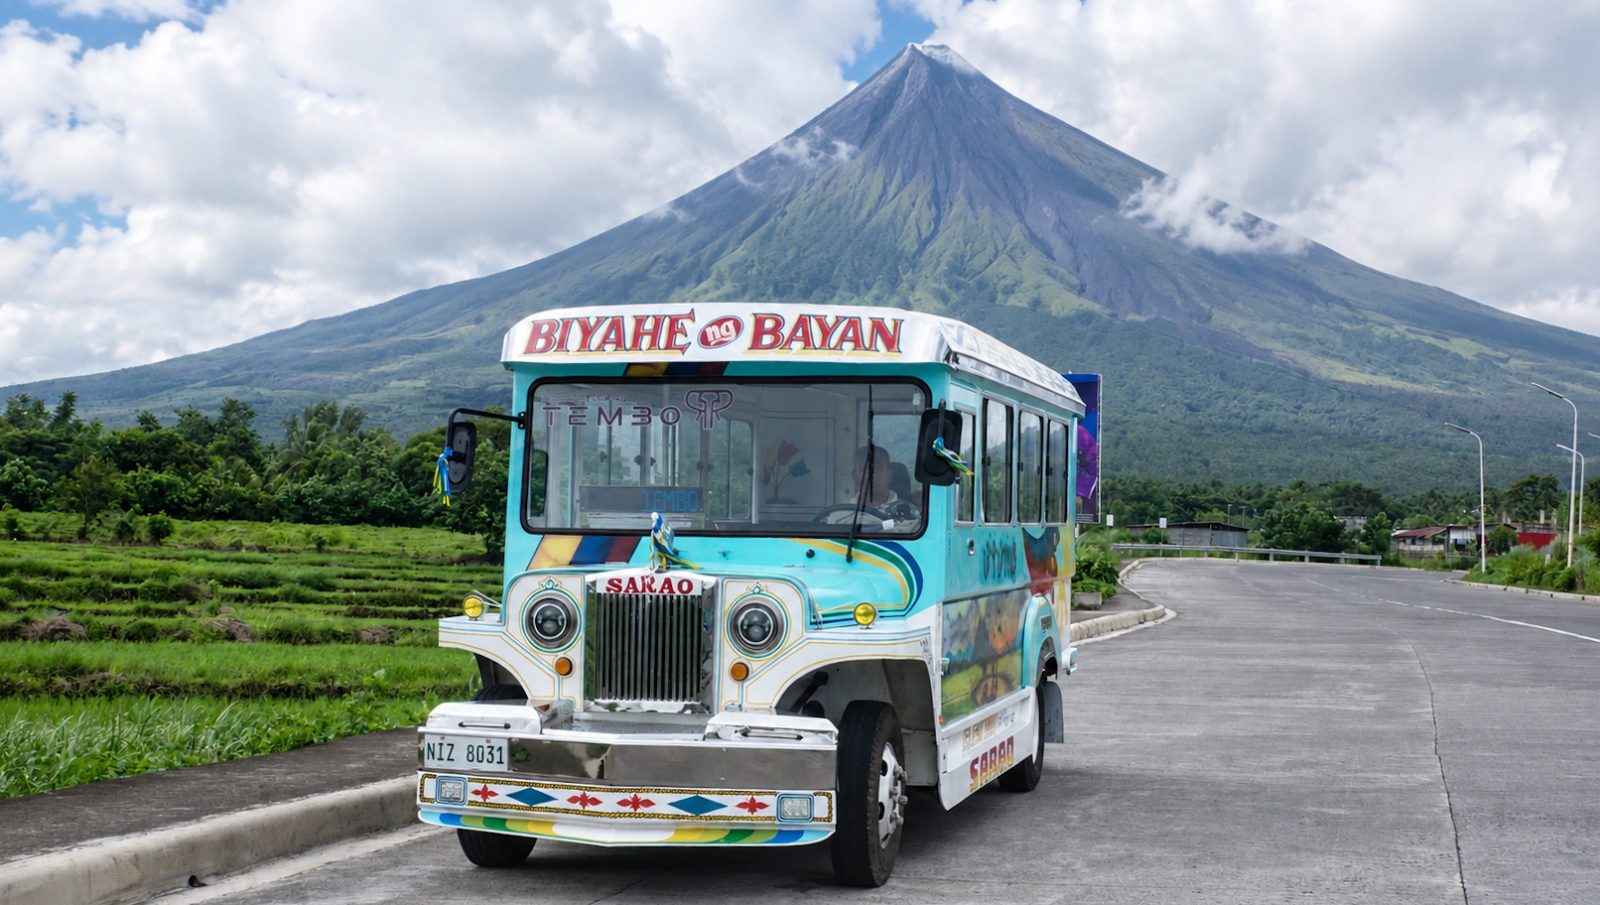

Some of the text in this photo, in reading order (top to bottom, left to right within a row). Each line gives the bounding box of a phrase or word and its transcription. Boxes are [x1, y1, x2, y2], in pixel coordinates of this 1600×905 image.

[523, 308, 905, 355] BIYAHE ng BAYAN
[542, 405, 681, 426] TEMBO
[605, 574, 694, 595] SARAO
[426, 742, 504, 765] NIZ 8031
